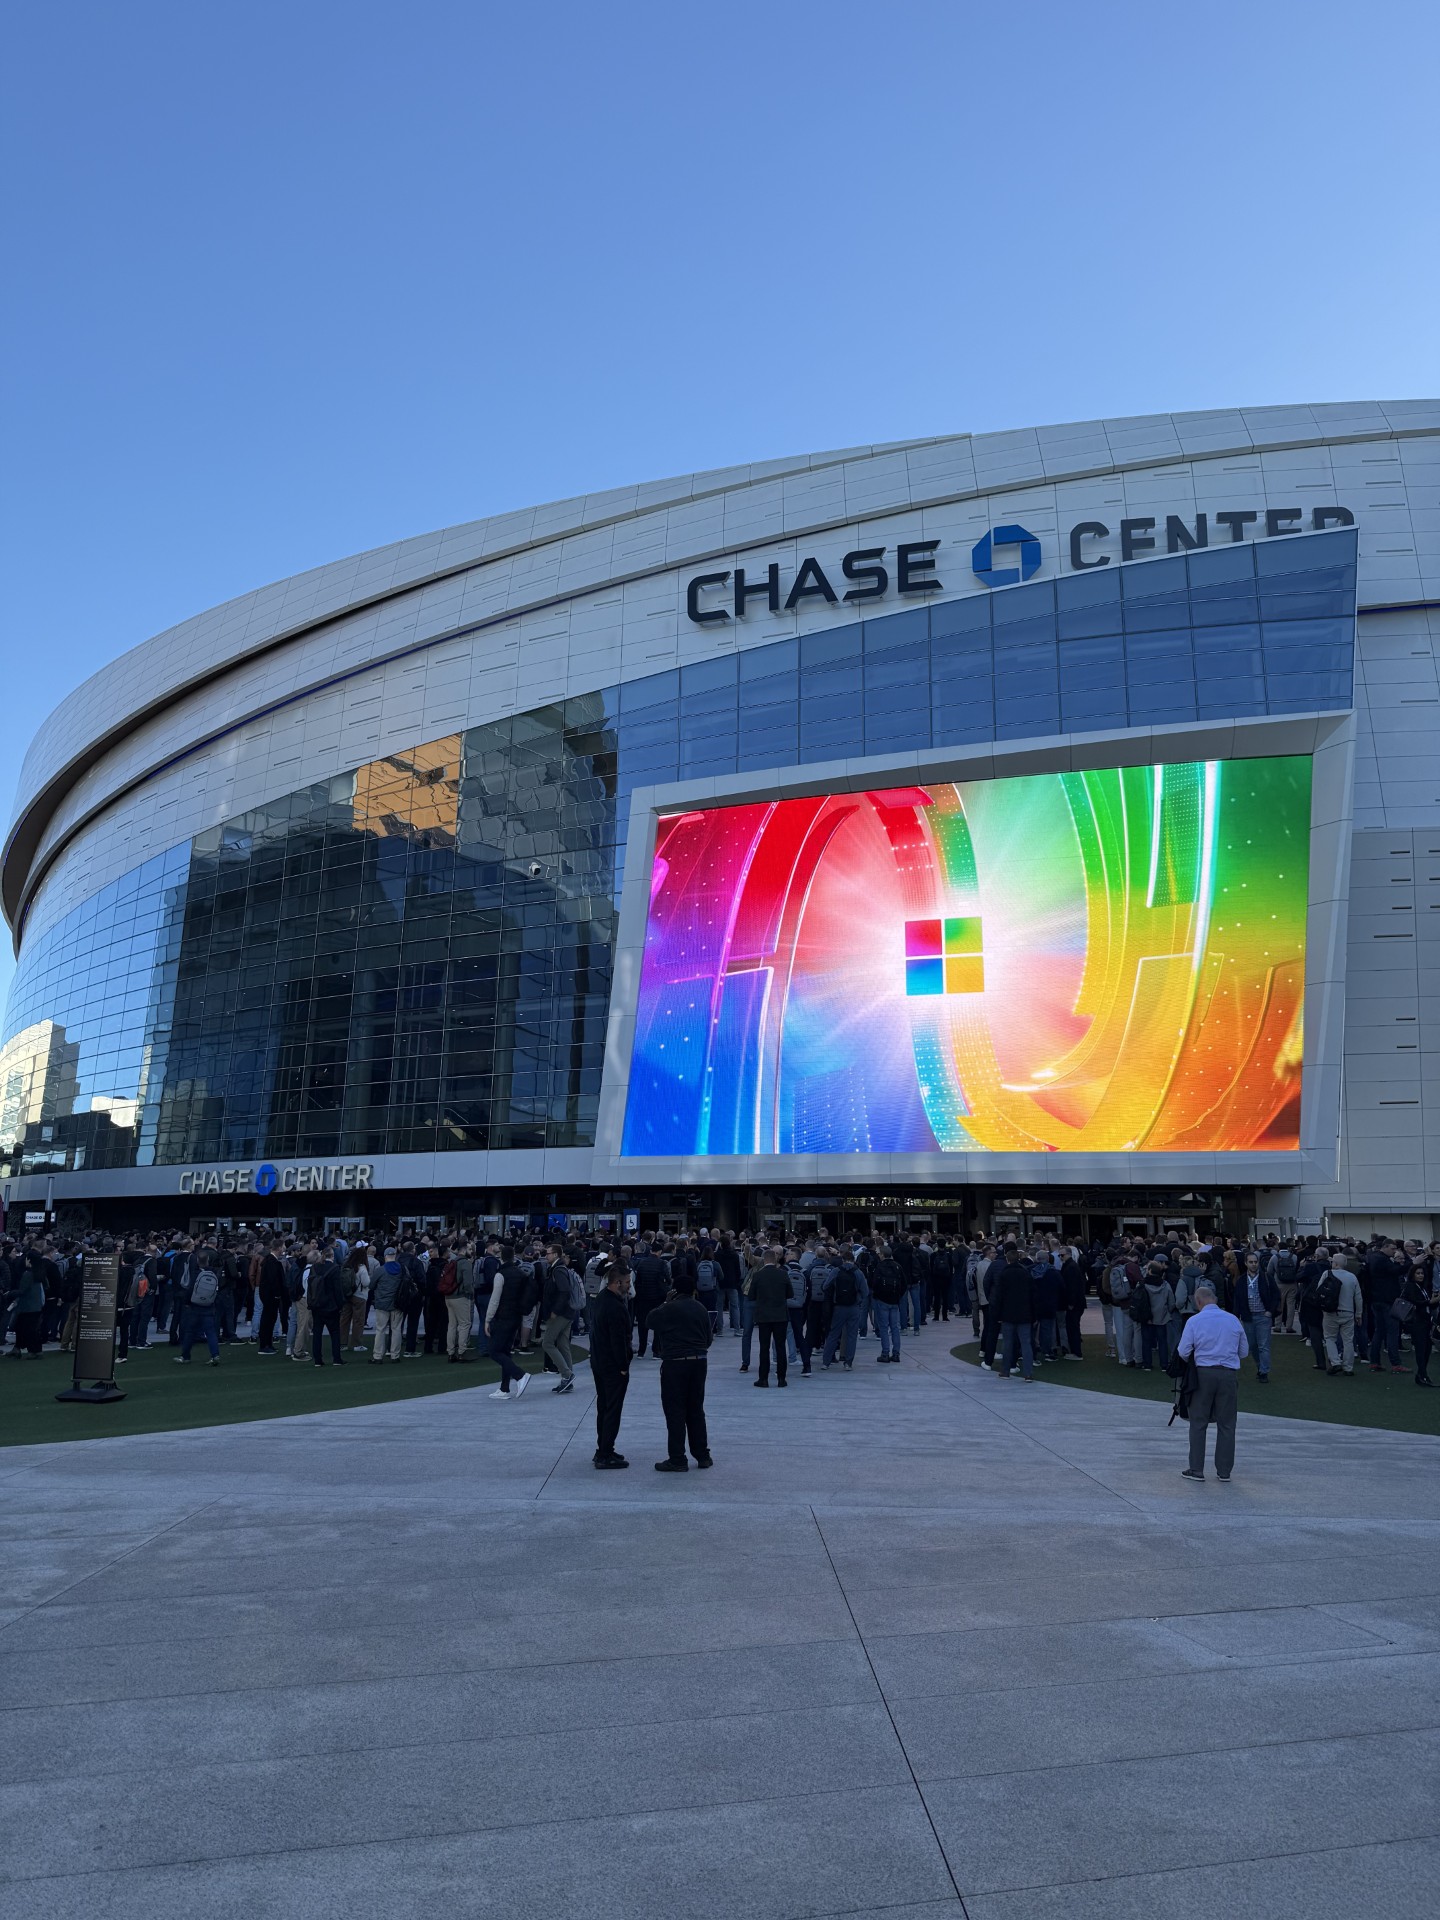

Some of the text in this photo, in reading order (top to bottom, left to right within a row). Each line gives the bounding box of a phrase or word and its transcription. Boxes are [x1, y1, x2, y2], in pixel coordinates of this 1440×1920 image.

[687, 539, 944, 624] CHASE
[180, 1164, 375, 1194] CHASE CENTER
